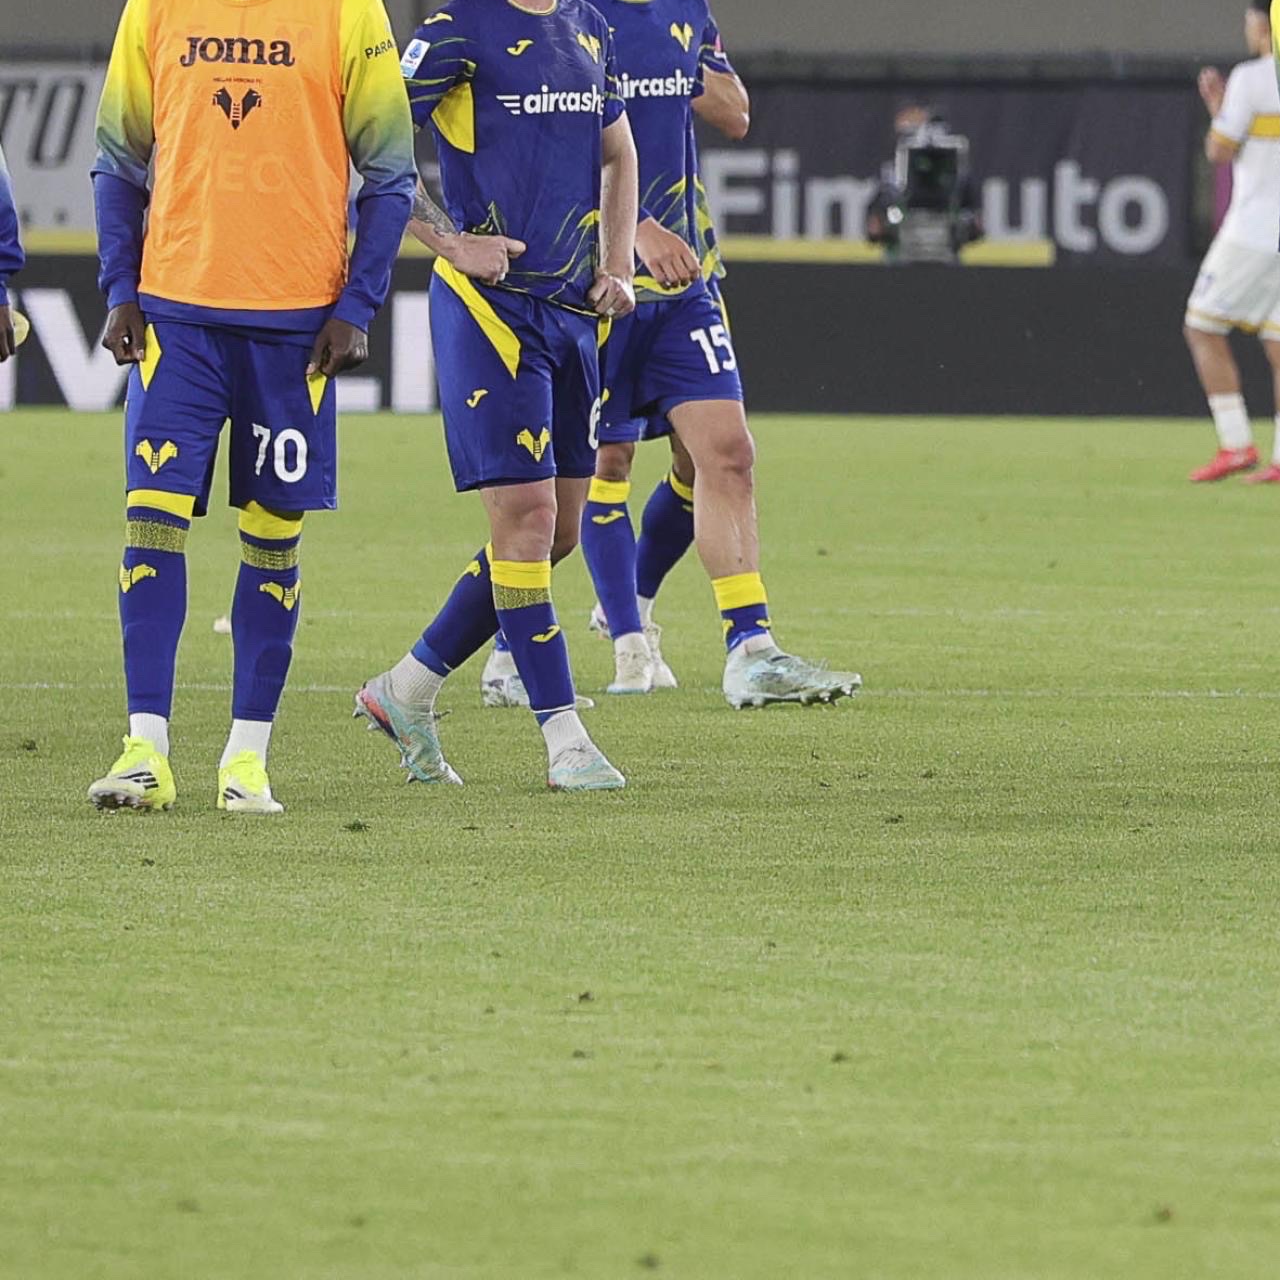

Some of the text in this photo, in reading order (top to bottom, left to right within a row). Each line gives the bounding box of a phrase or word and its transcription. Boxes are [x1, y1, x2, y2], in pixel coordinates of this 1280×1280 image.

[703, 149, 1169, 254] Fimuto
[690, 324, 735, 375] 15
[253, 424, 308, 483] 70
